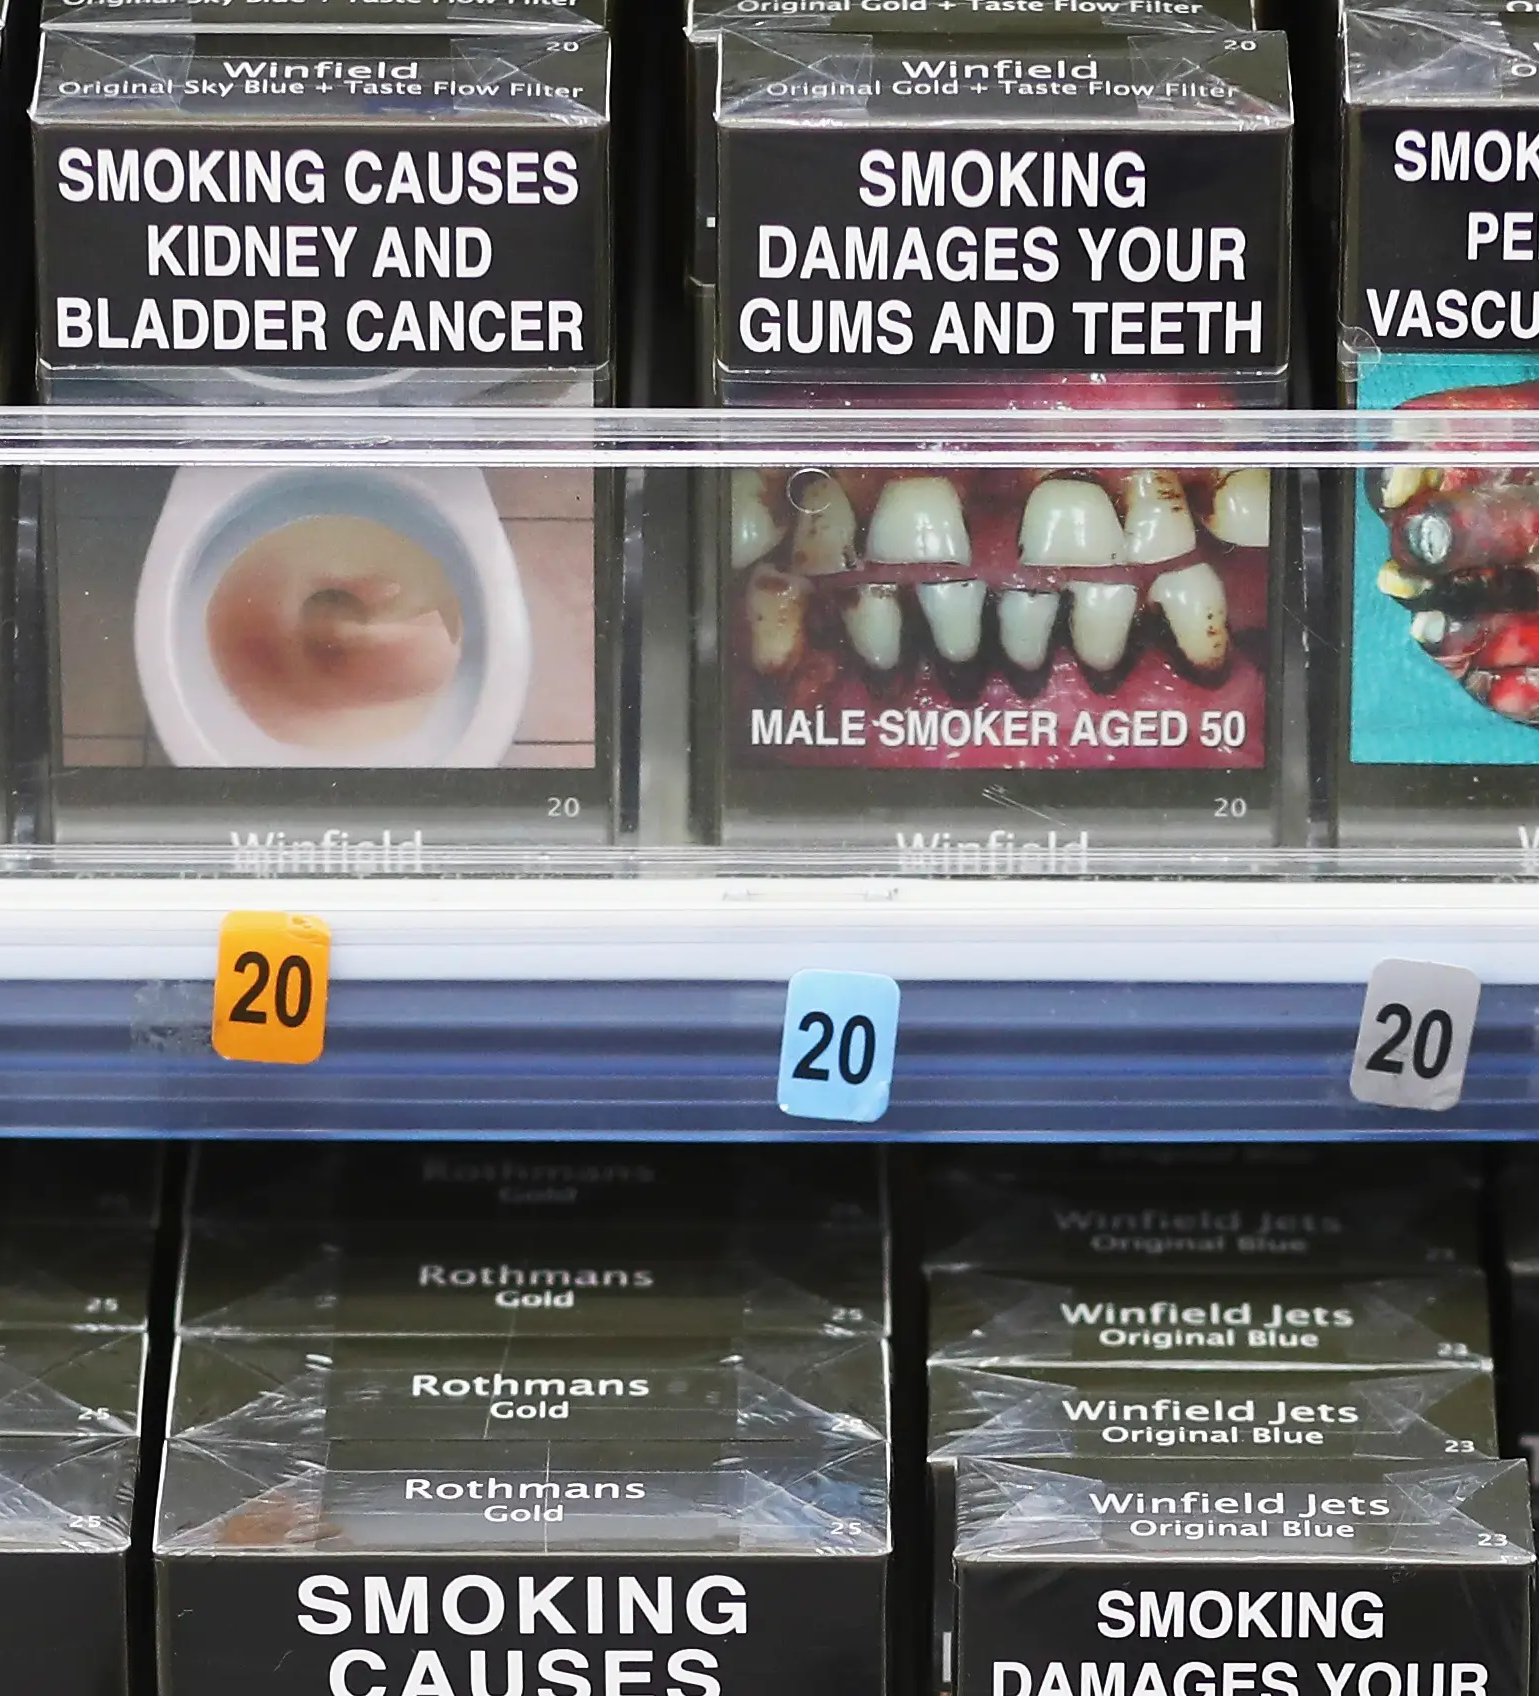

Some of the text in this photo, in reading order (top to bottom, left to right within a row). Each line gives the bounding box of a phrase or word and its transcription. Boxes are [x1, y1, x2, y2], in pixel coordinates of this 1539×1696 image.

[224, 62, 417, 79] Winfield
[59, 79, 173, 97] Original
[184, 80, 233, 97] Sky
[245, 79, 304, 93] Blue
[344, 80, 421, 94] Taste
[435, 81, 499, 95] Flow
[511, 83, 583, 99] Filter
[59, 148, 578, 204] SMOKING CAUSES
[148, 225, 491, 277] KIDNEY AND
[57, 297, 583, 352] BLADDER CANCER
[752, 707, 1245, 746] MALE SMOKER AGED 50
[229, 952, 311, 1027] 20
[792, 1012, 875, 1084] 20
[1366, 1004, 1452, 1079] 20
[1062, 1399, 1358, 1425] Winfield Jets
[1103, 1427, 1323, 1446] Original Blue
[1445, 1440, 1474, 1452] 23
[406, 1478, 645, 1501] Rothmans
[484, 1505, 563, 1522] Gold
[1089, 1492, 1389, 1517] Winfield Jets
[1130, 1520, 1354, 1539] Original Blue
[1478, 1534, 1508, 1546] 23
[298, 1575, 746, 1635] SMOKING
